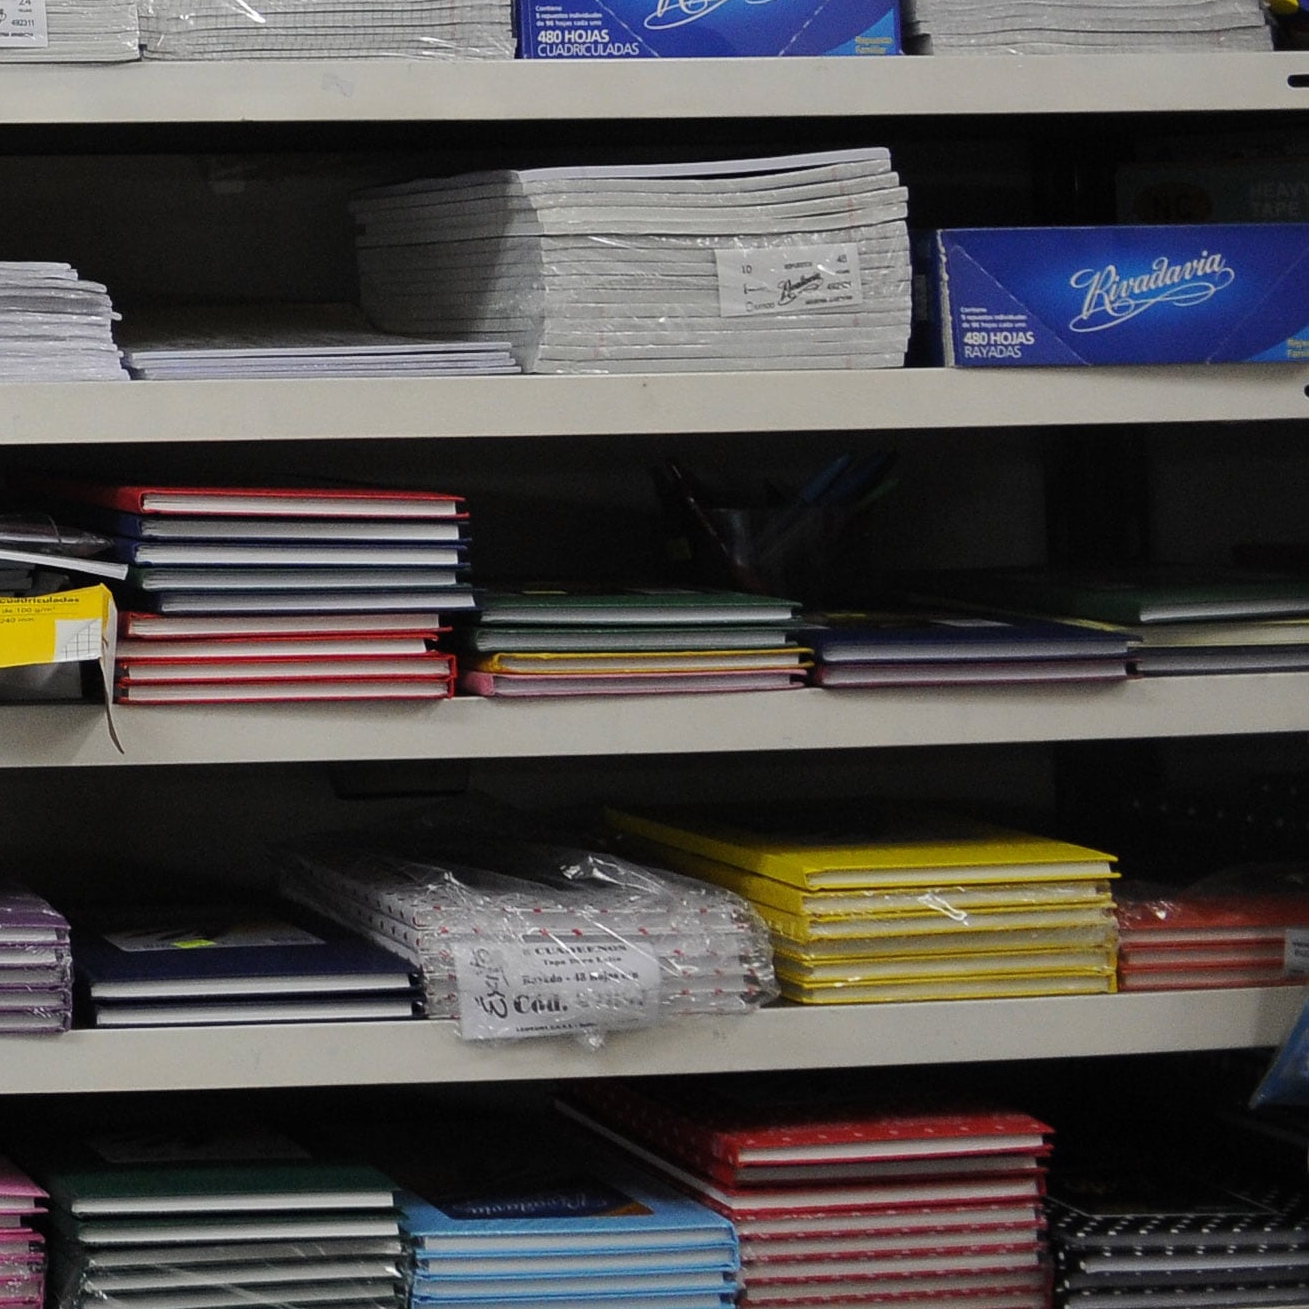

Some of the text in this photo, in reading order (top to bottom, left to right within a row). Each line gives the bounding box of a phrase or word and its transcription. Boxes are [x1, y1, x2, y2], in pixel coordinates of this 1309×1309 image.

[537, 29, 609, 44] 480 HOJAS
[537, 42, 639, 57] CUADRICULADAS
[1070, 250, 1234, 330] Rivadavia
[964, 331, 1034, 345] 480 HOJAS
[964, 345, 1022, 359] RAYADAS
